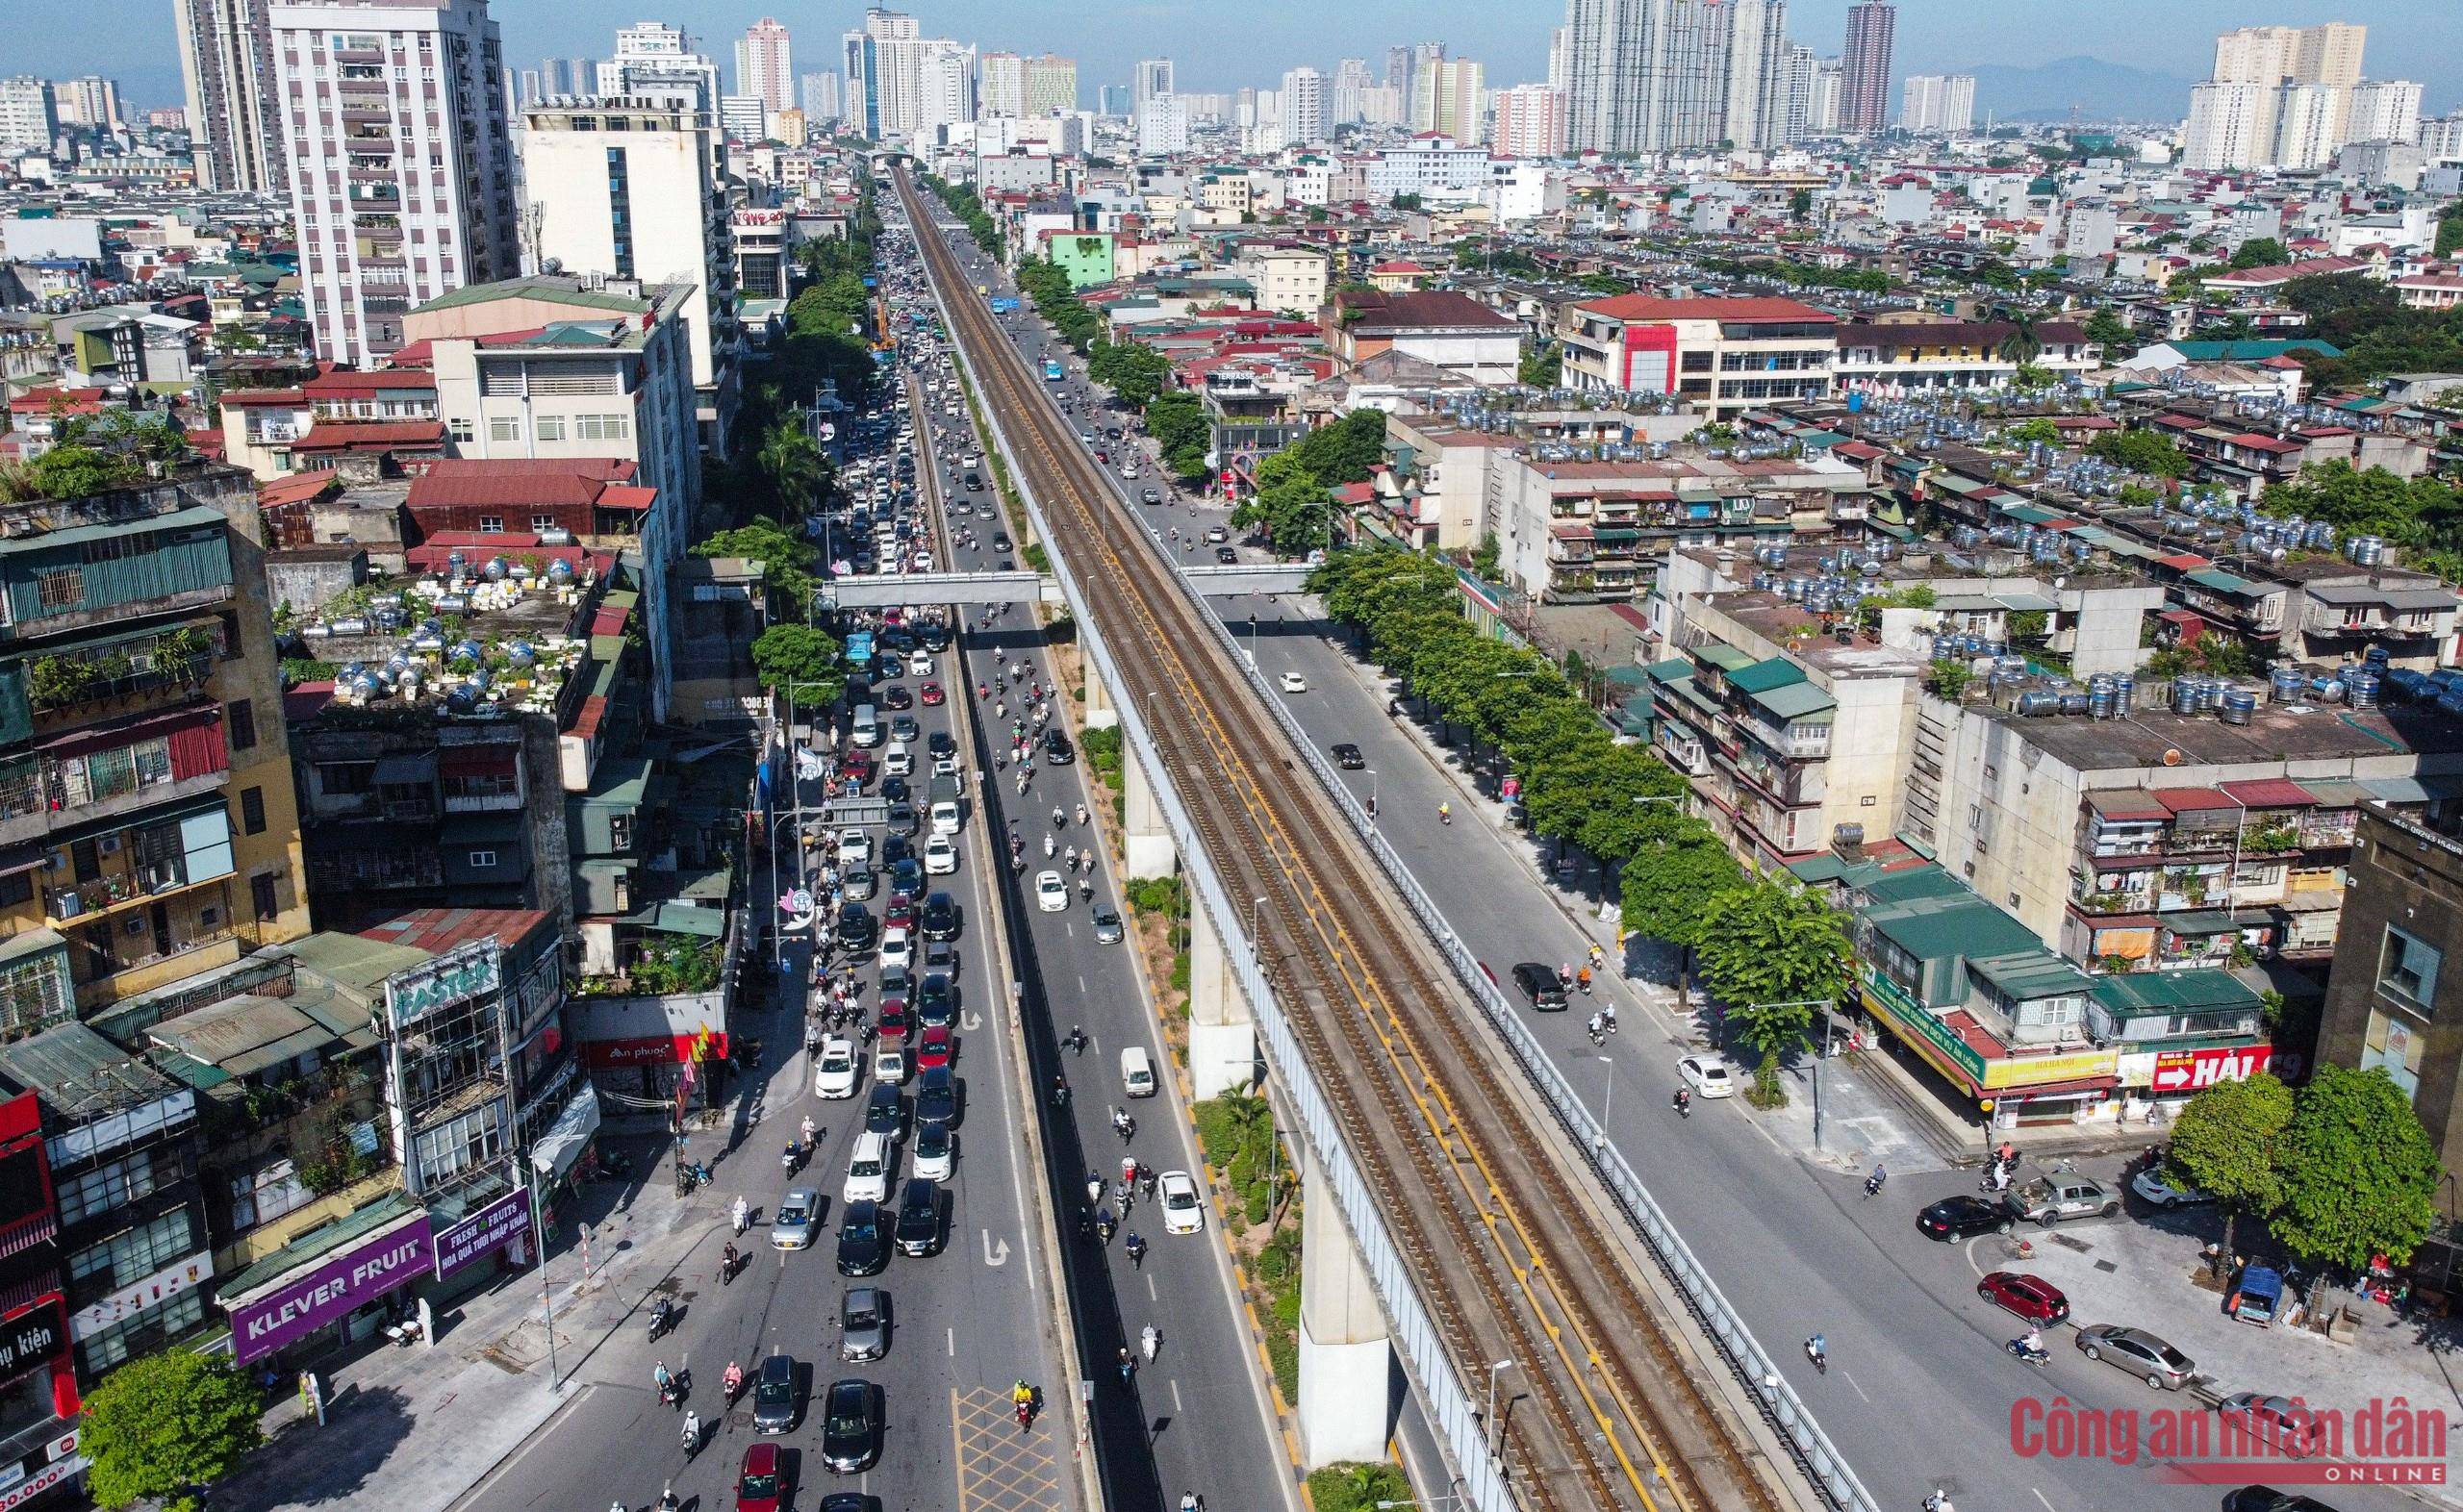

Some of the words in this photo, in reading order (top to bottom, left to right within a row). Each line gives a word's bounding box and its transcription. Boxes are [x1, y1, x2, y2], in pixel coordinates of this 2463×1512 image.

[443, 1254, 457, 1270] HOA
[490, 1223, 509, 1242] NHẬP
[450, 1223, 478, 1248] FRESH
[488, 1201, 518, 1226] FRUITS
[248, 1276, 347, 1340] KLEVER
[352, 1239, 419, 1287] FRUIT
[17, 1327, 52, 1356] kiện
